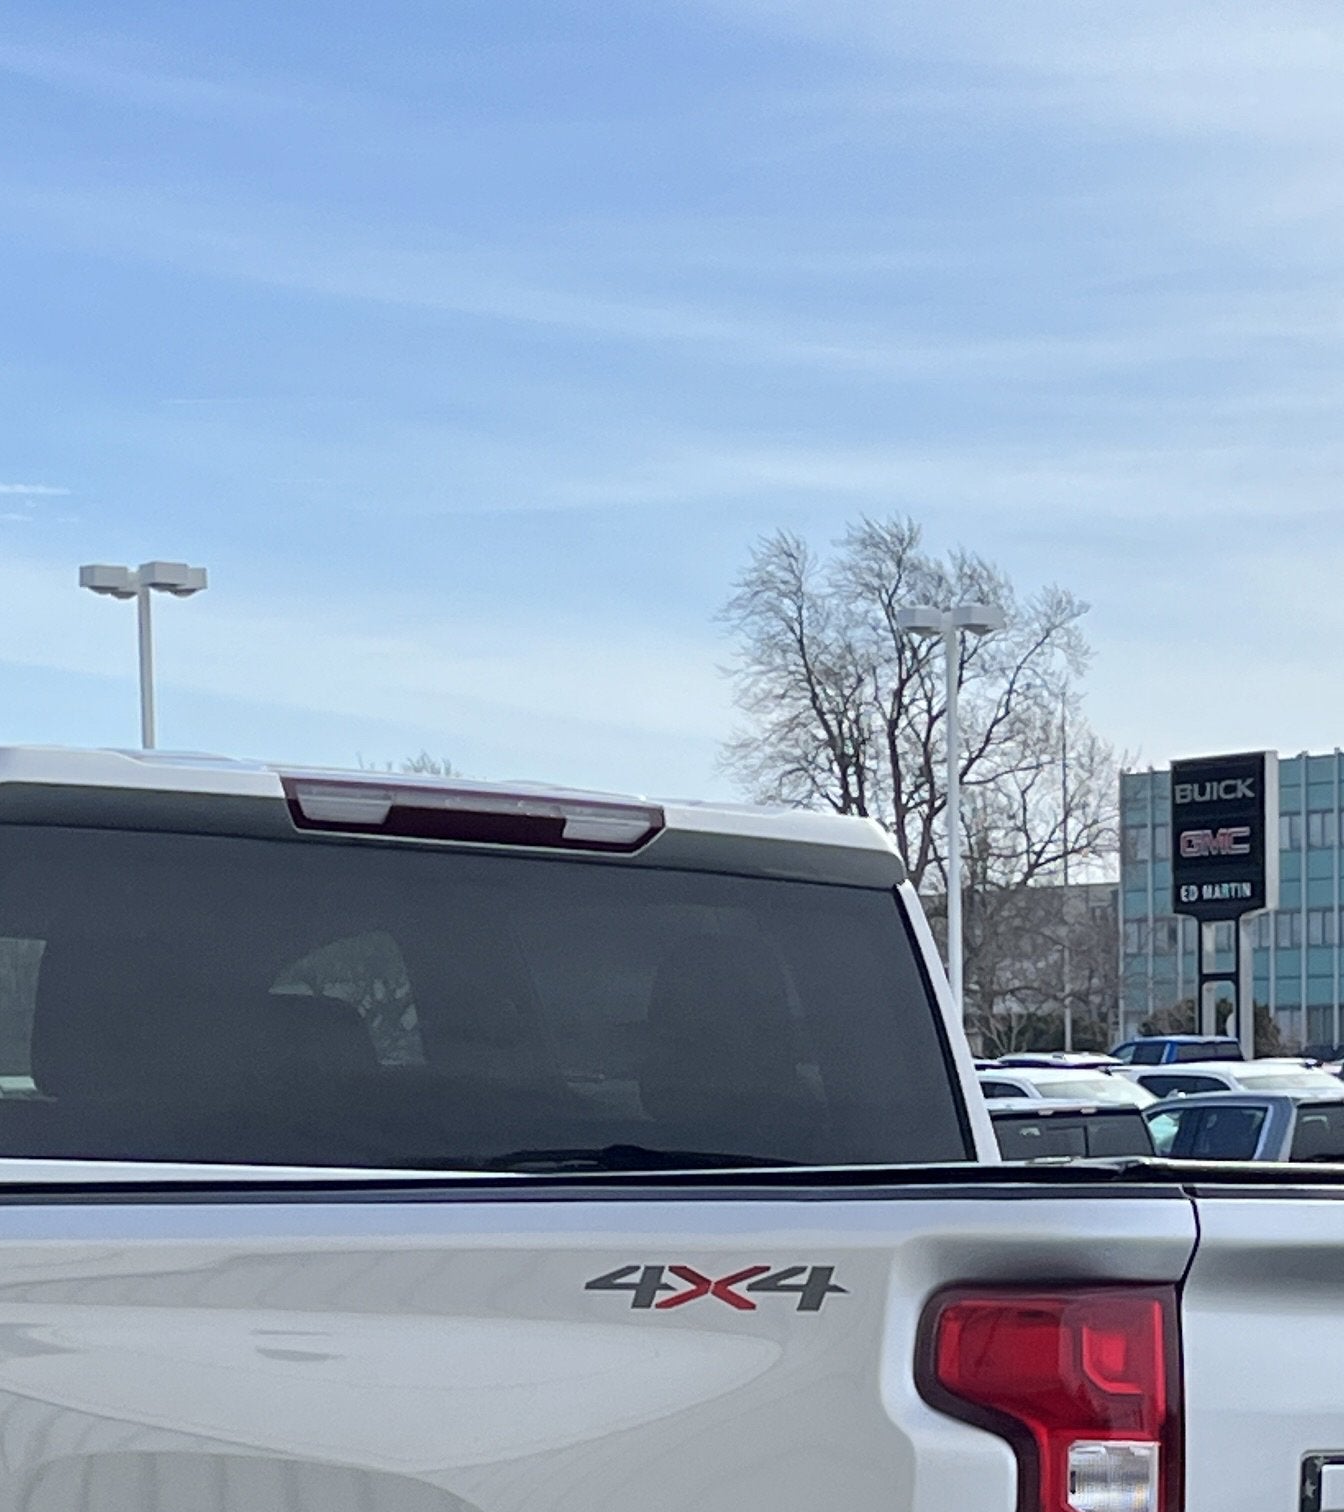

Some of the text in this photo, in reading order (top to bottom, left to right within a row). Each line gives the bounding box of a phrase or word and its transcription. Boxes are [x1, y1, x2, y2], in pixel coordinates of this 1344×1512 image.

[1174, 777, 1255, 804] BUICK
[1179, 826, 1251, 858] GMC
[1180, 882, 1252, 902] ED MARTIN
